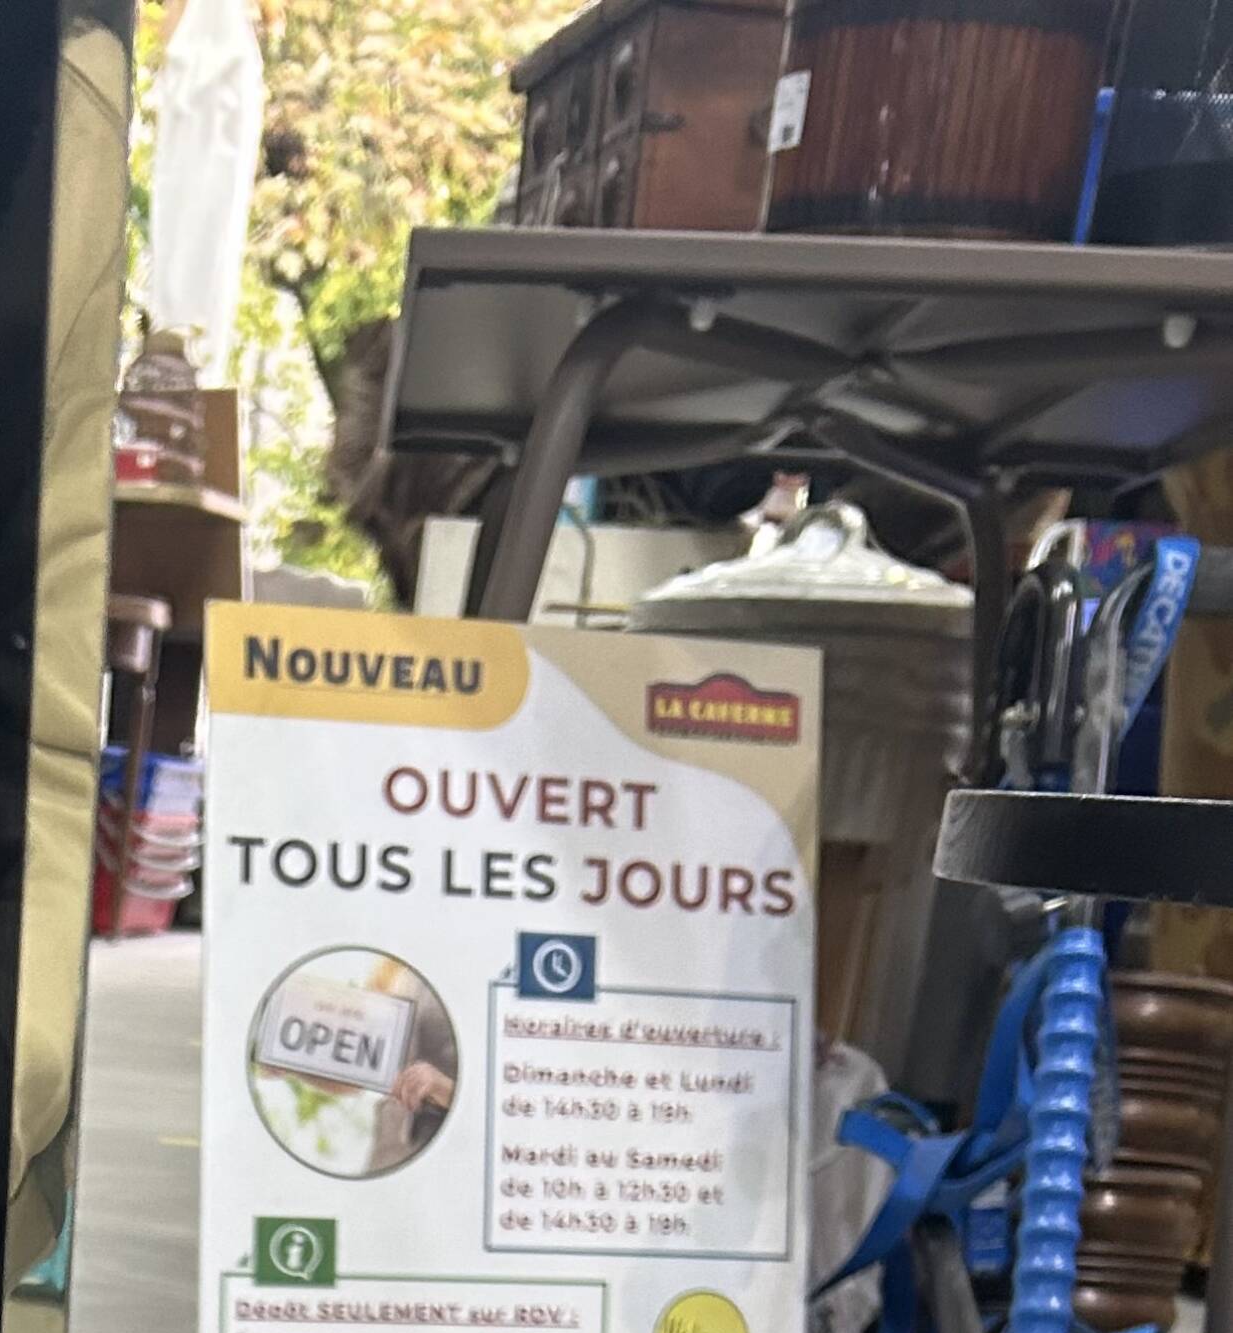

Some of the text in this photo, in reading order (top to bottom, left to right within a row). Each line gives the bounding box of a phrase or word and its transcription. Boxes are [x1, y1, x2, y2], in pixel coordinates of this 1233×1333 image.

[244, 636, 484, 695] NOUVEAU
[654, 697, 683, 718] LA
[384, 766, 658, 830] OUVERT
[227, 836, 797, 917] TOUS LES JOURS
[279, 1015, 386, 1071] OPEN
[503, 1061, 754, 1094] Dimanche et Lundi
[502, 1096, 535, 1116] de
[544, 1096, 619, 1120] 14h30
[501, 1145, 722, 1172] Mardi au Samedi
[500, 1177, 533, 1198] de
[698, 1185, 724, 1204] et
[500, 1209, 533, 1230] de
[542, 1209, 616, 1233] 14h30
[317, 1301, 461, 1322] SEULEMENT
[470, 1306, 507, 1323] sur
